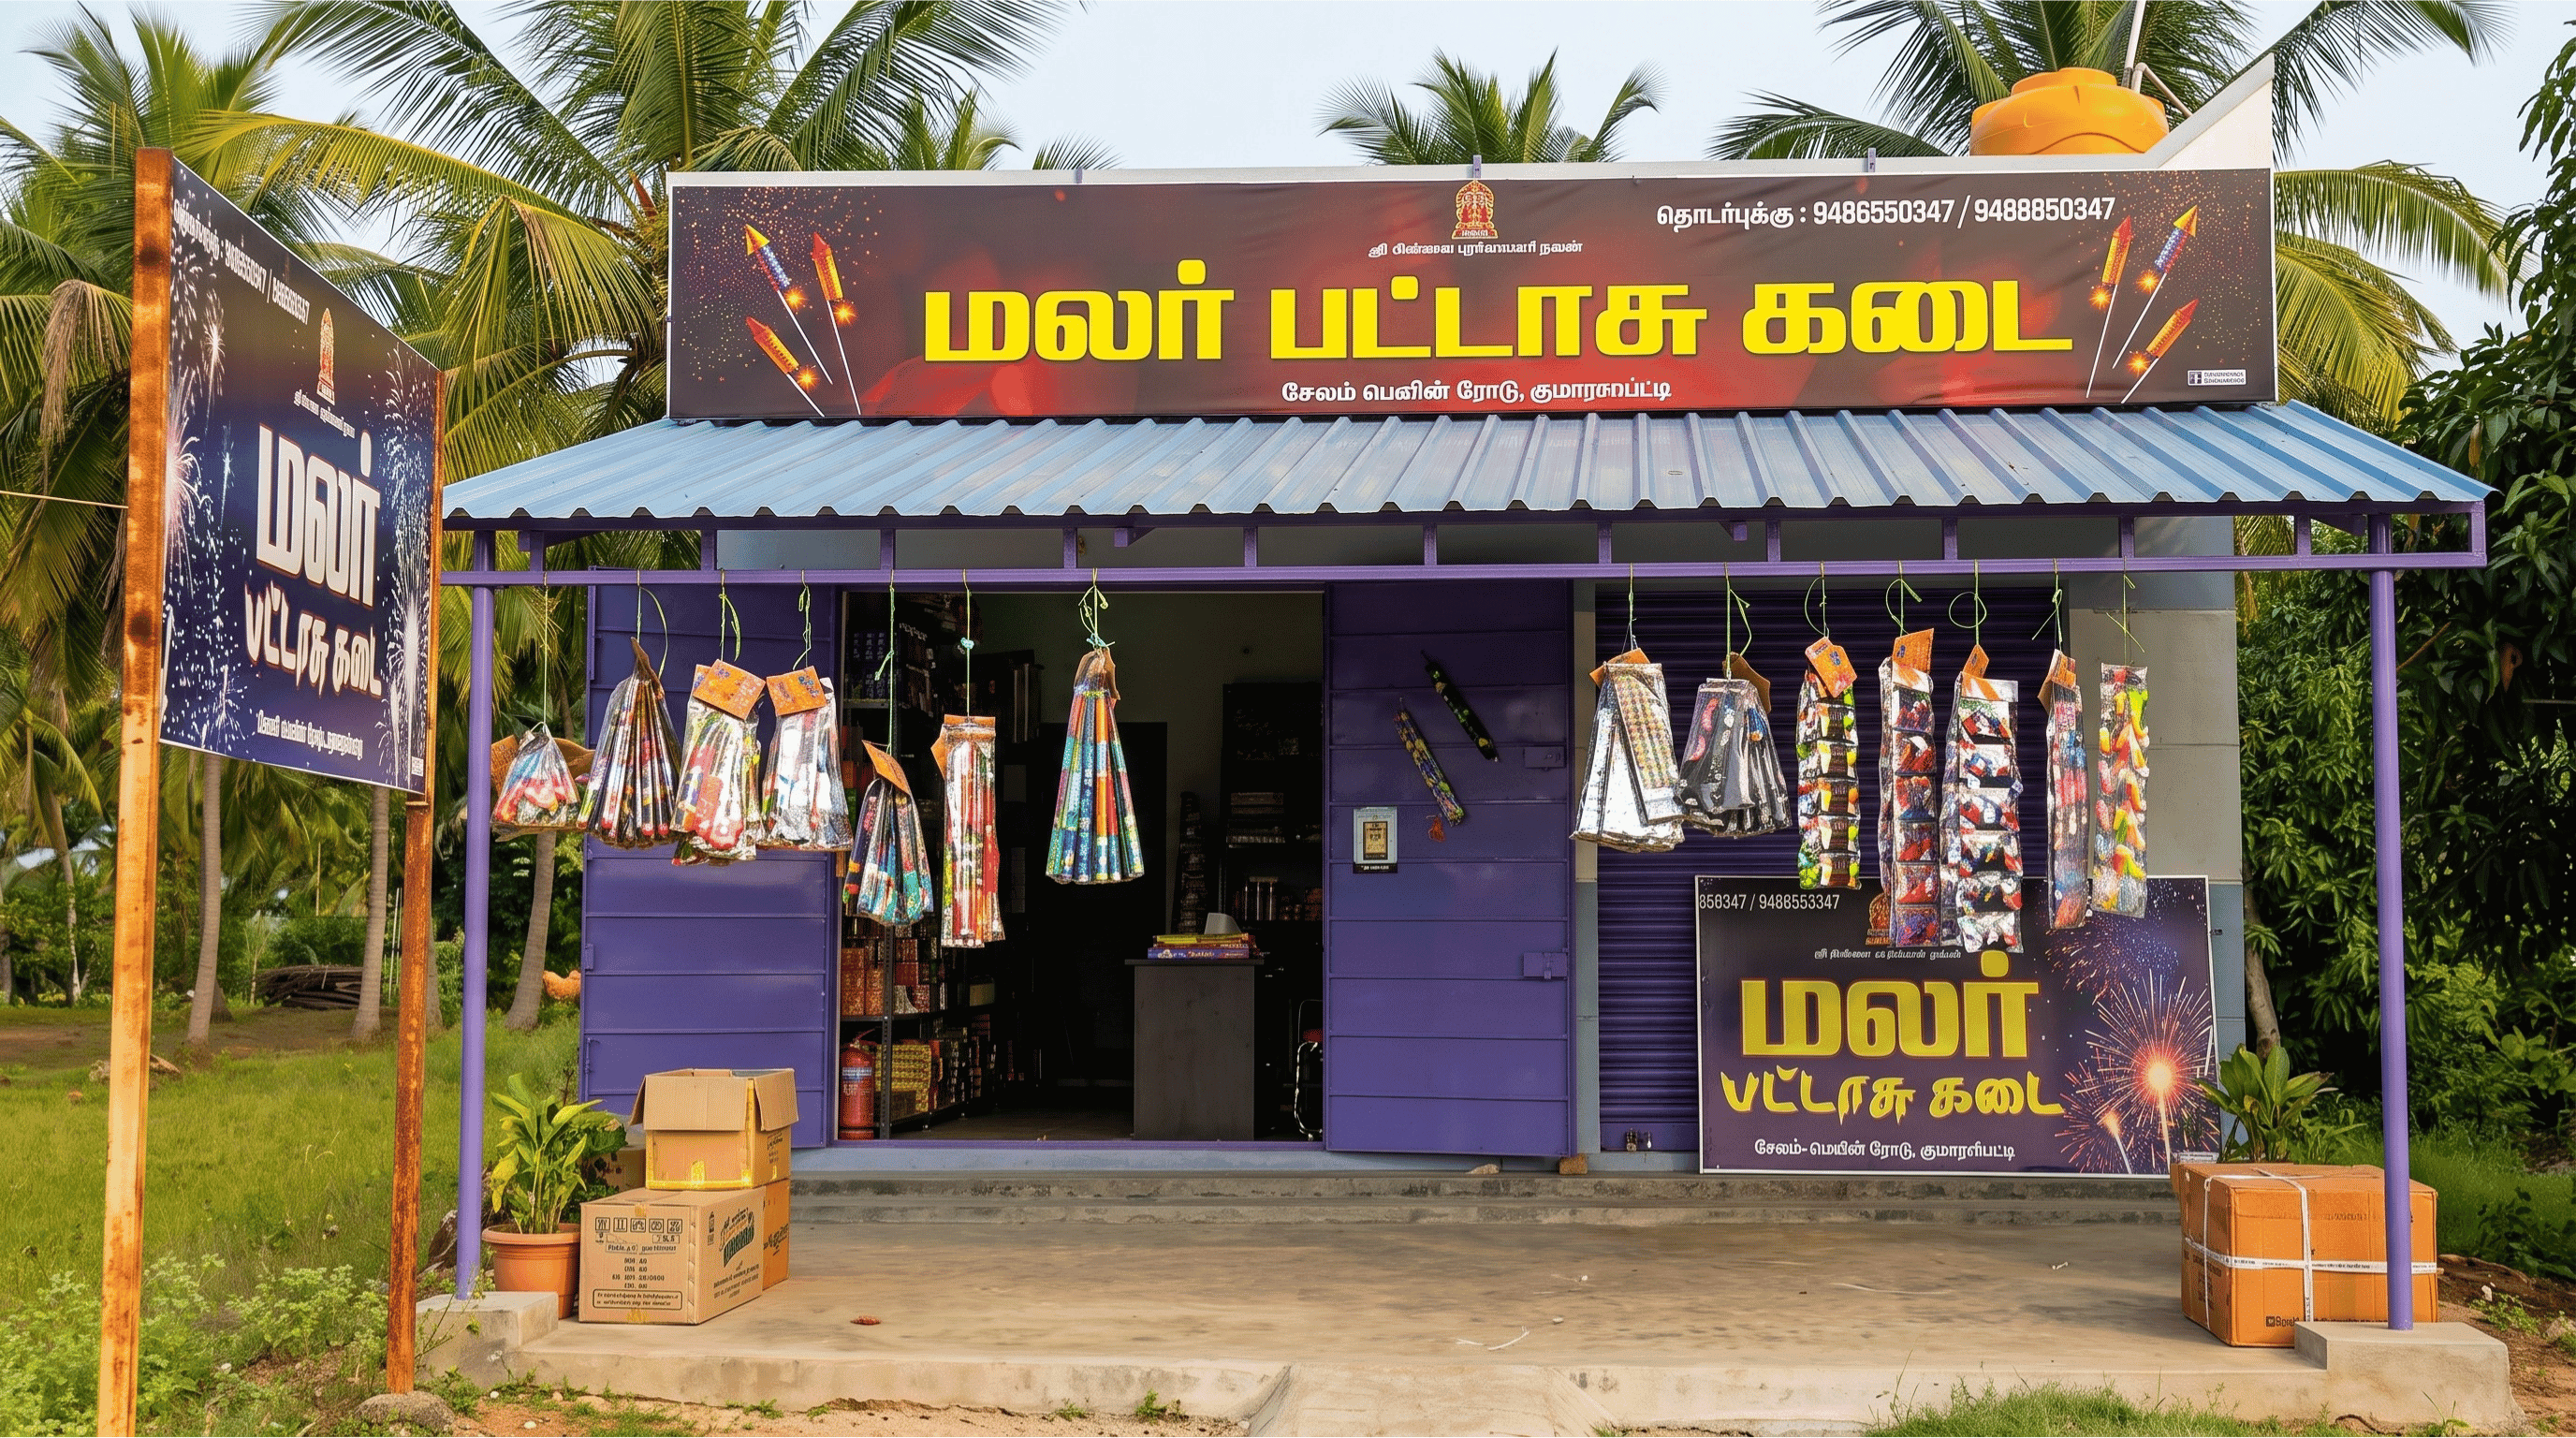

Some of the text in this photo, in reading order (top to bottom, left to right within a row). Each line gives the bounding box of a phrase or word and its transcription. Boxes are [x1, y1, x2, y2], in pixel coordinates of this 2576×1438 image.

[1656, 204, 1795, 232] தொடர்புக்கு
[1813, 199, 1955, 225] 9486550347
[1956, 195, 1971, 229] /
[1974, 196, 2116, 222] 9488850347
[923, 258, 2074, 362] மலர் பட்டாசு கடை
[1281, 380, 1357, 402] சேலம்
[1456, 380, 1525, 404] ரோடு,
[256, 424, 380, 607] மலர்
[244, 579, 382, 697] பட்டாசு கடை
[1739, 948, 2040, 1059] மலர்
[1720, 1064, 2066, 1124] பட்டாசு கடை
